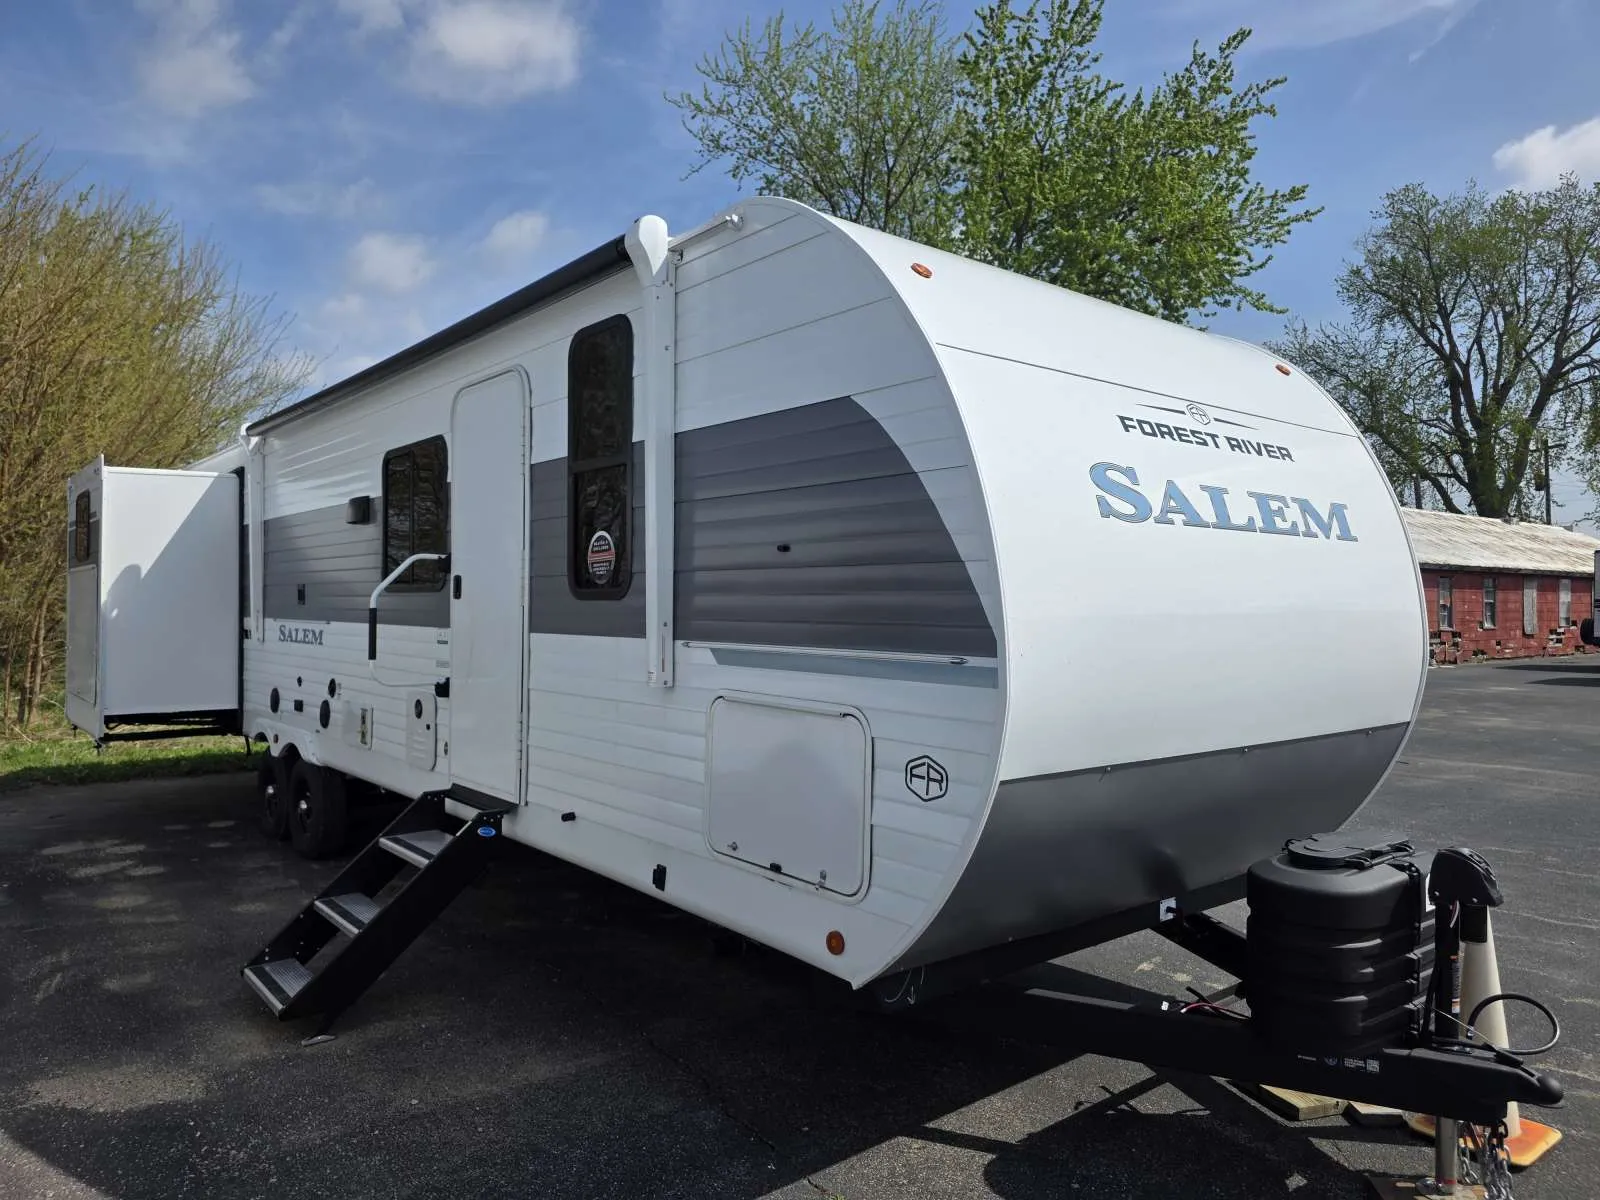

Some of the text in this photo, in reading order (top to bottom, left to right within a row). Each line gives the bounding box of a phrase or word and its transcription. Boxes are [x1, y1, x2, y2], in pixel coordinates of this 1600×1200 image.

[1116, 415, 1295, 462] FOREST RIVER
[1089, 462, 1358, 542] SALEM
[279, 624, 324, 645] SALEM
